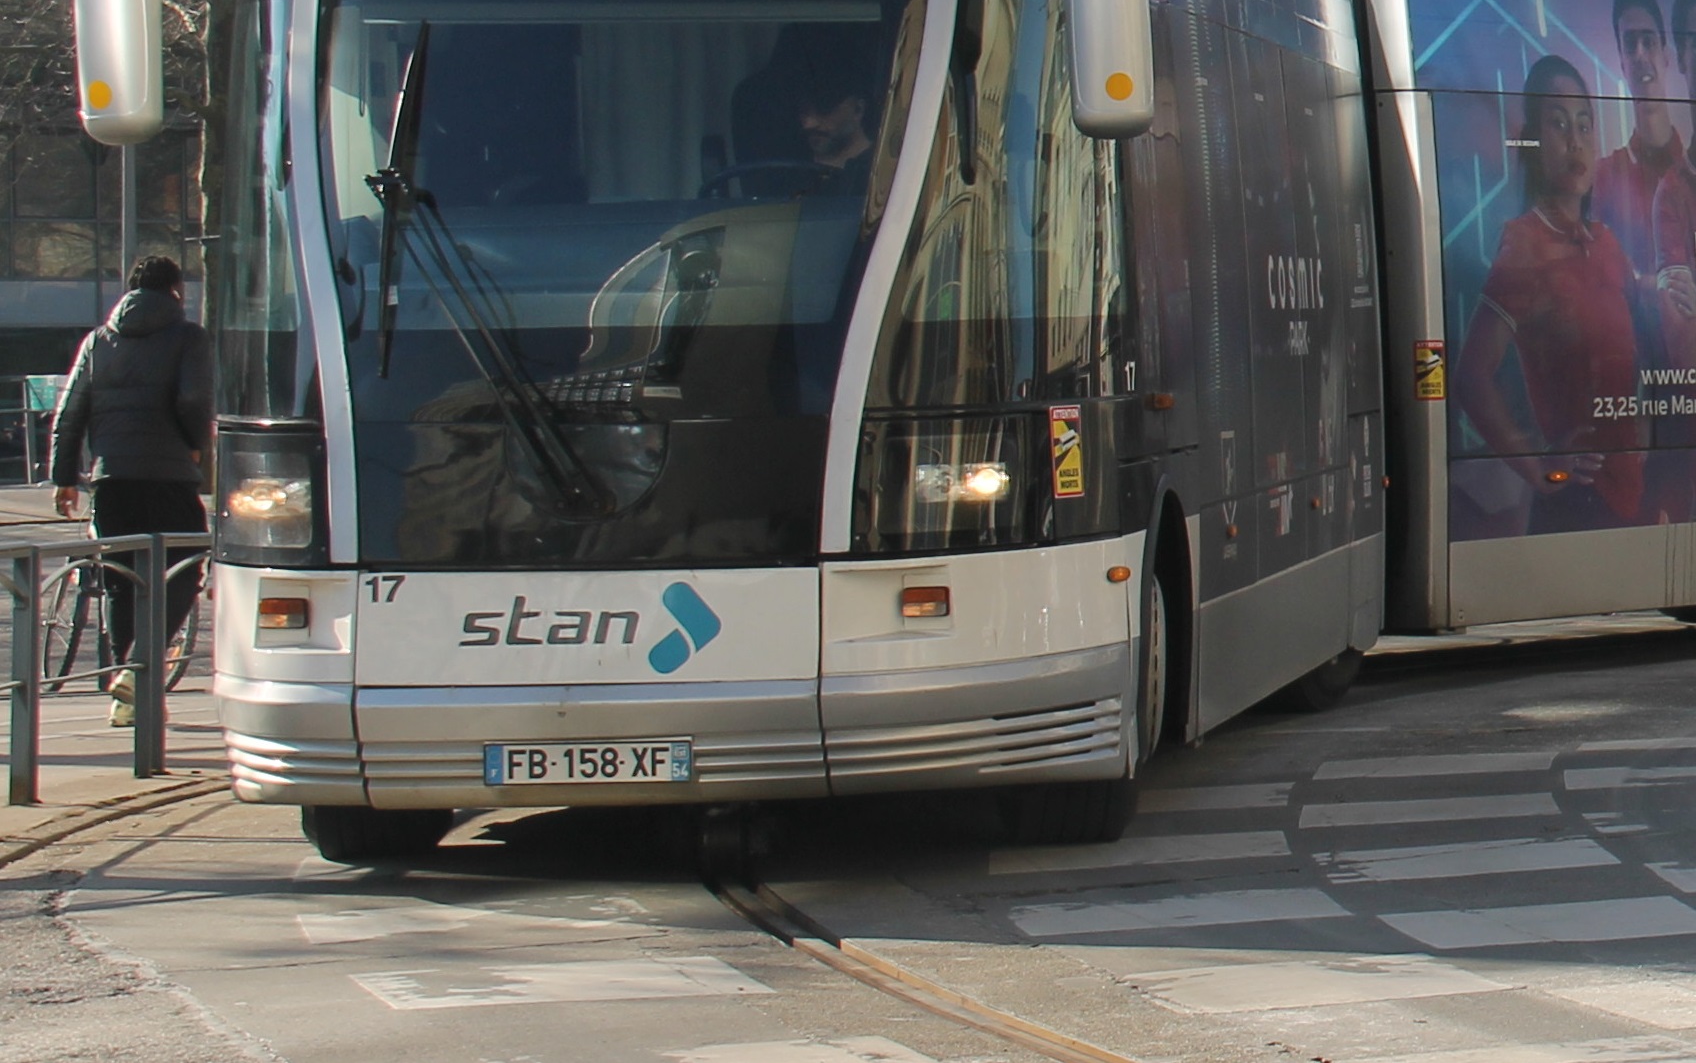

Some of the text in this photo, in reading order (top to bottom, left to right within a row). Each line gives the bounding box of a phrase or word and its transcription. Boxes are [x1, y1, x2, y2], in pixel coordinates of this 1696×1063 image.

[1267, 254, 1324, 310] COSMIC
[1124, 360, 1136, 392] 17
[1592, 396, 1638, 421] 23,25
[1641, 399, 1668, 417] rue
[365, 574, 407, 604] 17
[458, 594, 641, 647] stan
[673, 762, 688, 777] 54
